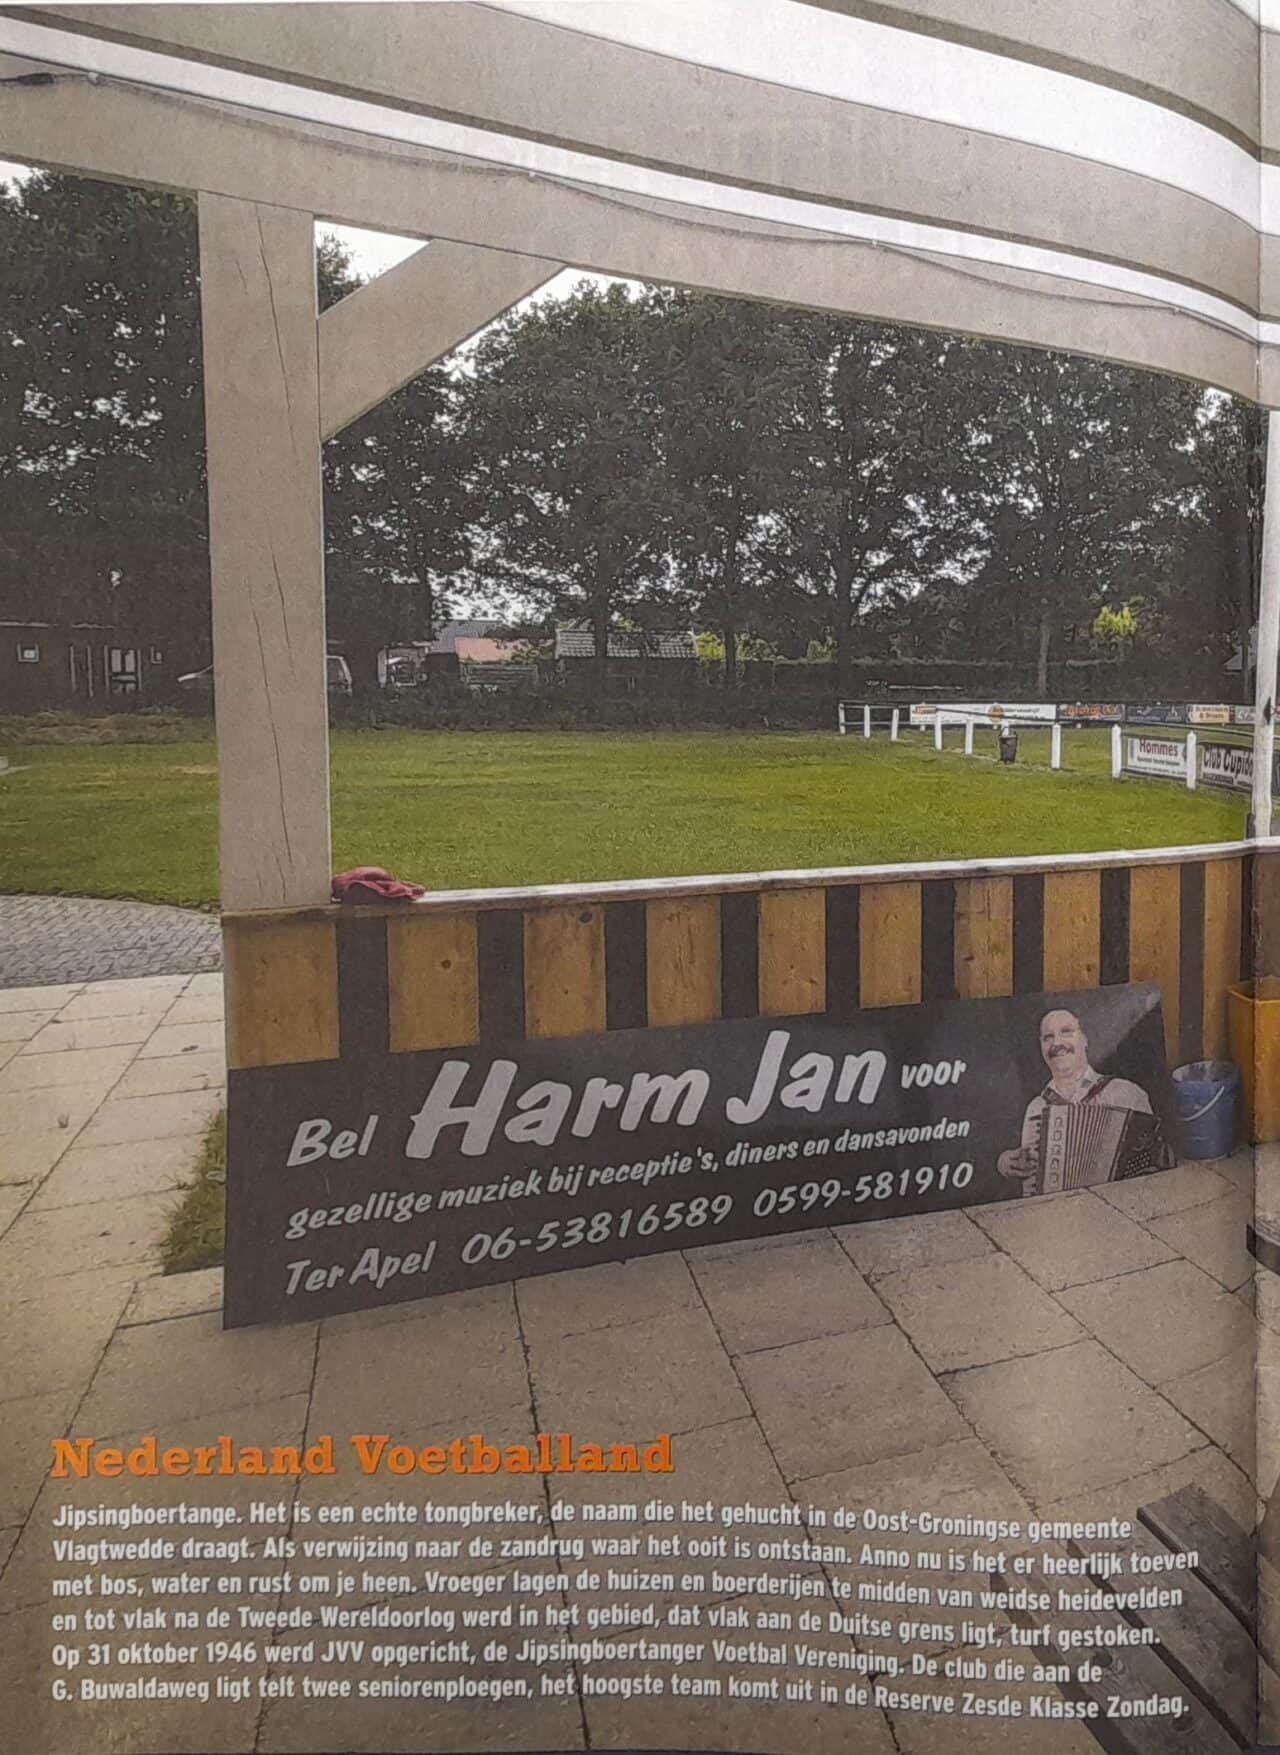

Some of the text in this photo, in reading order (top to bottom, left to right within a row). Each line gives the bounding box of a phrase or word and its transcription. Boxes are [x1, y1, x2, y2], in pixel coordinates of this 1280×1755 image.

[1140, 738, 1178, 757] Hommes
[286, 1030, 967, 1167] Bel Harm Jan voor
[285, 1117, 971, 1240] gezellige muziek bij receptie's, diners en dansavonden
[285, 1162, 974, 1296] Ter Apel 06-53816589 0599-581910
[50, 1434, 675, 1478] Nederland Voetballand
[52, 1499, 1132, 1544] Jipsingboertange. Het is een echte tongbreker, de naam die het gehucht in Oost-Groningse gemeente
[52, 1535, 1199, 1580] Vlagtwedde draagt. Als verwijzing naar zandrug waar ooit ontstaan. Anno nu er heerlijk toeven
[52, 1568, 1183, 1611] met bos, water en rust om je heen. Vroeger lagen huizen boerderijen te midden van weidse heidevelden
[84, 1602, 1161, 1652] tot vlak na Tweede Wereldoorlog werd gebied, dat aan Duitse grens ligt, turf gestoken.
[51, 1638, 987, 1680] Op 31 oktober 1946 JVV opgericht, Jipsingboertanger Voetbal Vereniging. De club
[51, 1673, 1190, 1719] G. Buwaldaweg ligt telt twee seniorenploegen, hoogste team komt uit Reserve Zesde Klasse Zondag.
